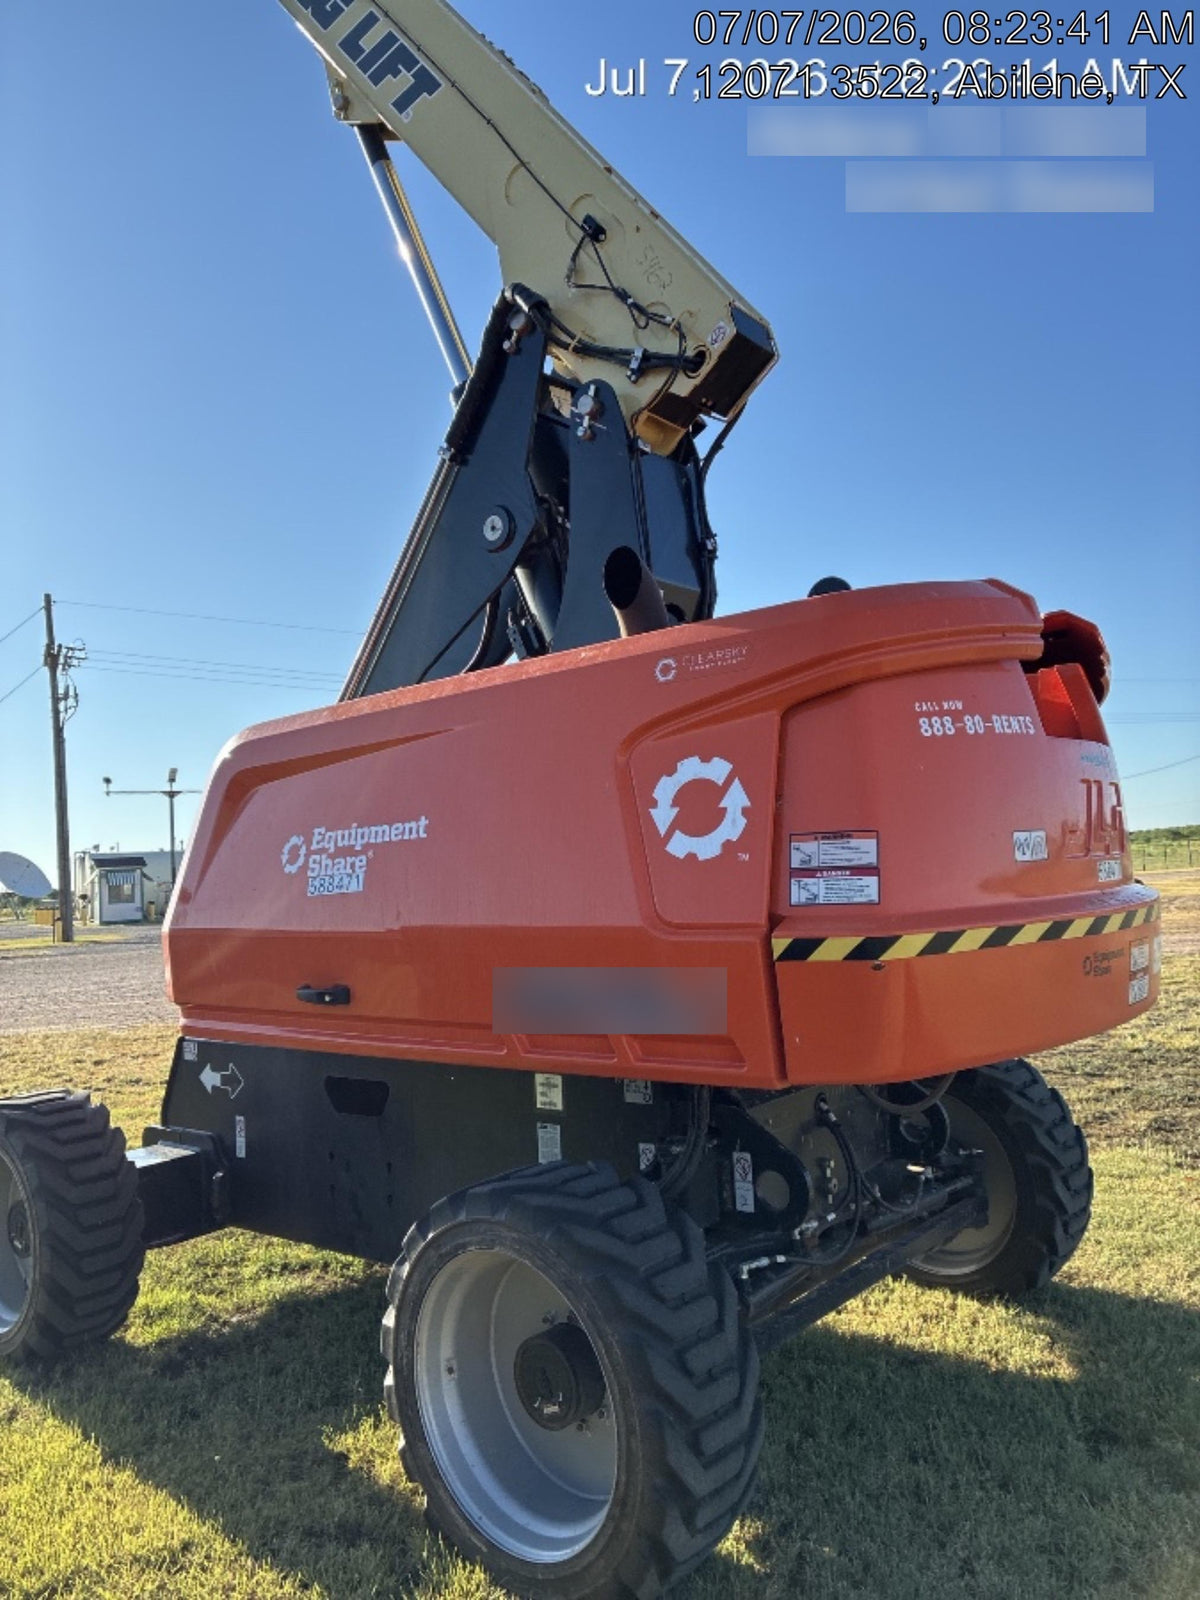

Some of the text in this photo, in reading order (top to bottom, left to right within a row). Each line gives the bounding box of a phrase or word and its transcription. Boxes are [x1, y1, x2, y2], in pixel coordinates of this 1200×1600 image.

[336, 9, 445, 116] LIFT
[914, 700, 963, 712] CALL NOW
[918, 713, 1036, 737] 888-80-RENTS
[310, 815, 429, 852] Equipment
